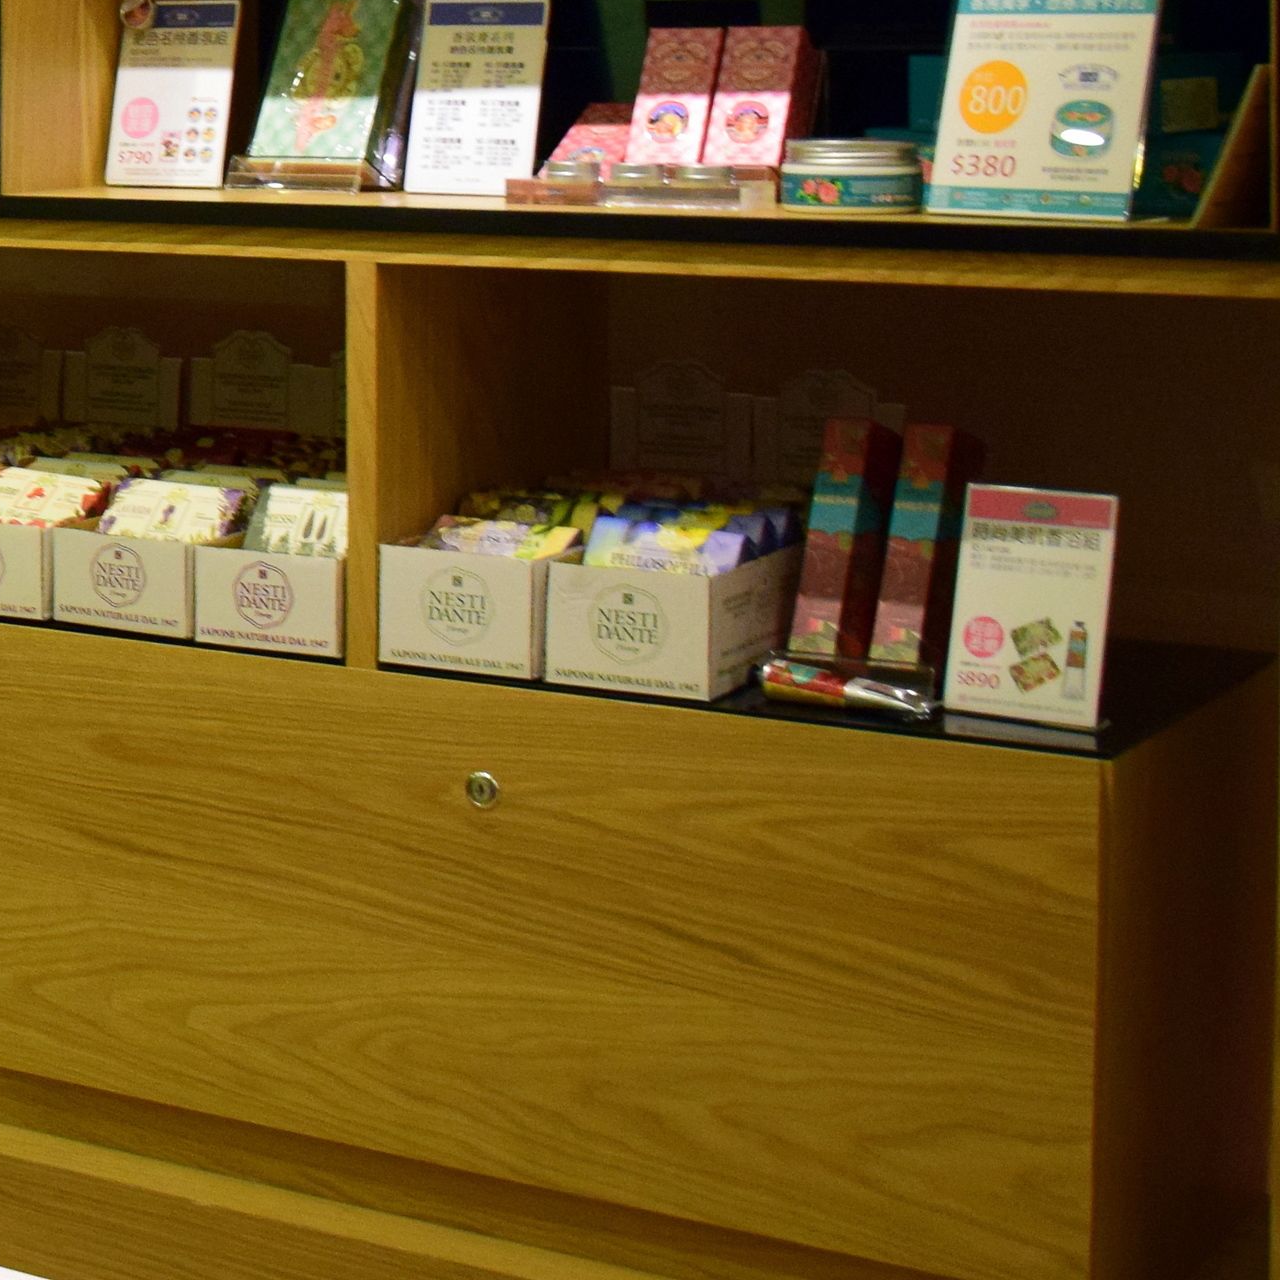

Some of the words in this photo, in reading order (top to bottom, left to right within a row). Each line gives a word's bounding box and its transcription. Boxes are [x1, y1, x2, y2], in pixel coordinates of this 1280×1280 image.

[967, 84, 1026, 117] 800
[117, 149, 153, 164] $790
[950, 154, 1017, 179] $380
[96, 560, 142, 579] NESTI
[96, 574, 142, 592] DANTE
[238, 581, 287, 599] NESTI
[238, 595, 288, 612] DANTE
[428, 589, 487, 611] NESTI
[428, 605, 487, 627] DANTE
[597, 607, 660, 630] NESTI
[596, 623, 660, 646] DANTE
[956, 670, 1001, 690] $890
